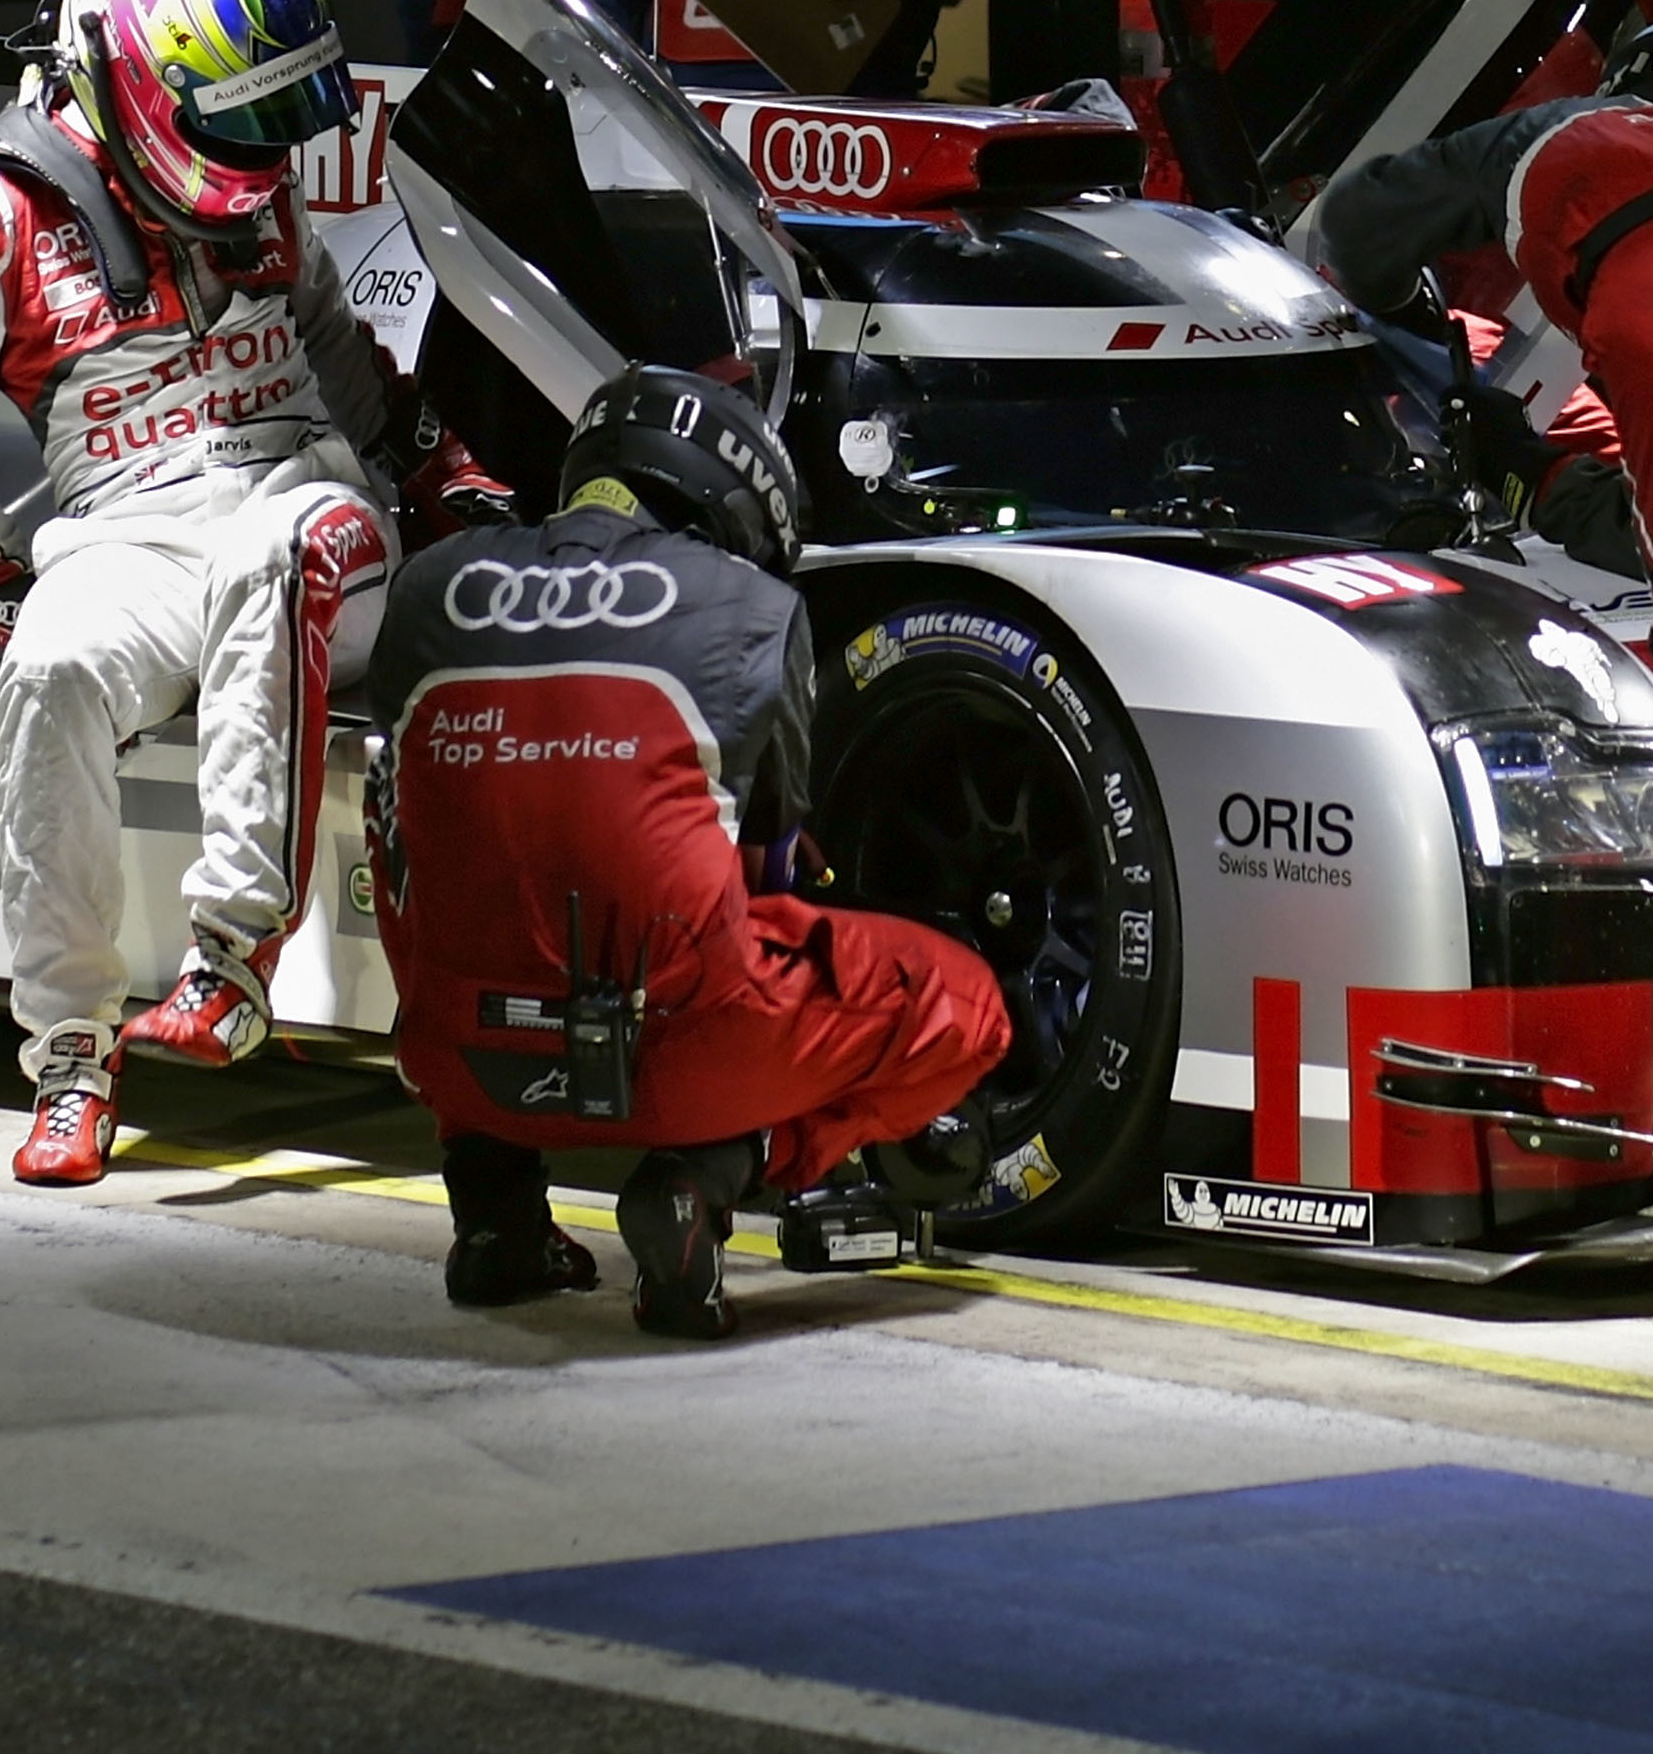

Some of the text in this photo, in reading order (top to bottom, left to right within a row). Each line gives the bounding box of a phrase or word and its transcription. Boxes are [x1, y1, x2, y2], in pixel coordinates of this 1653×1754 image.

[213, 83, 251, 103] Audi
[252, 50, 322, 89] Vorsprung
[352, 269, 423, 308] ORIS
[93, 293, 161, 330] Audi
[1184, 320, 1293, 345] Audi
[84, 377, 294, 462] quattro
[205, 437, 252, 455] Jarvis
[717, 428, 797, 556] uvex
[1258, 553, 1436, 603] HY
[902, 611, 1032, 659] MICHELIN
[430, 707, 505, 736] Audi
[1054, 675, 1092, 728] MICHELIN
[427, 732, 639, 770] Top Service
[1103, 772, 1134, 839] AUDI
[1218, 791, 1355, 858] ORIS
[1218, 853, 1353, 888] Swiss Watches
[1223, 1192, 1367, 1229] MICHELIN
